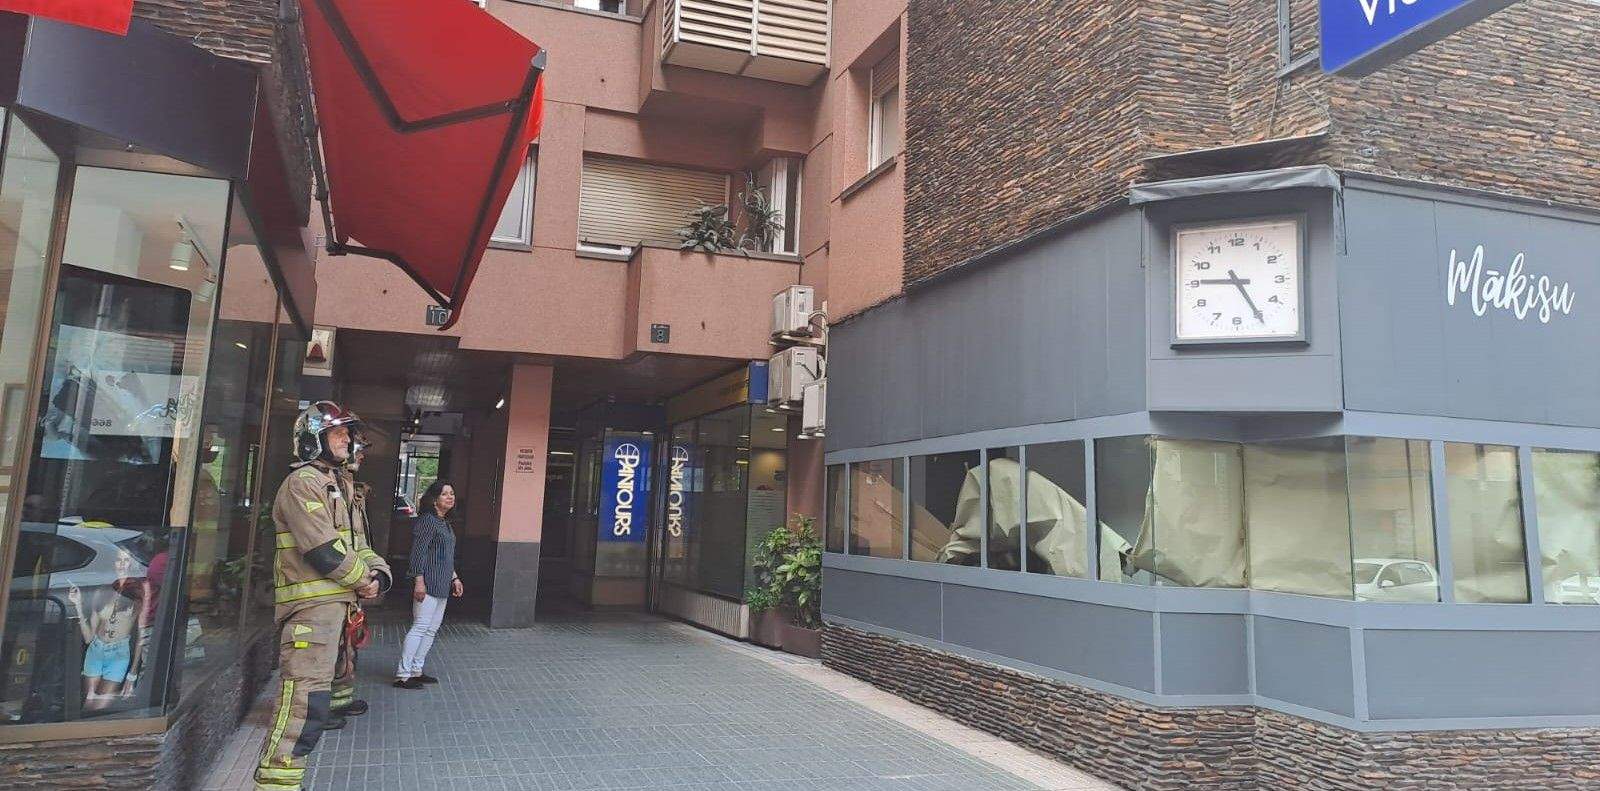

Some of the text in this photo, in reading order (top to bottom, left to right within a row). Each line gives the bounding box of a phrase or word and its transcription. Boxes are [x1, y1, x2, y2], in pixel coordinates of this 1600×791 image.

[1228, 238, 1245, 247] 12
[1253, 243, 1260, 251] 1
[1208, 245, 1221, 254] 11
[1267, 255, 1278, 264] 2
[1194, 261, 1211, 270] 10
[1190, 280, 1200, 288] 9
[1274, 275, 1285, 284] 3
[1197, 299, 1207, 307] 8
[1268, 295, 1278, 303] 4
[431, 310, 448, 325] 10
[1212, 312, 1222, 321] 7
[1232, 317, 1242, 325] 6
[656, 329, 665, 342] 8
[614, 452, 640, 536] PANTOURS
